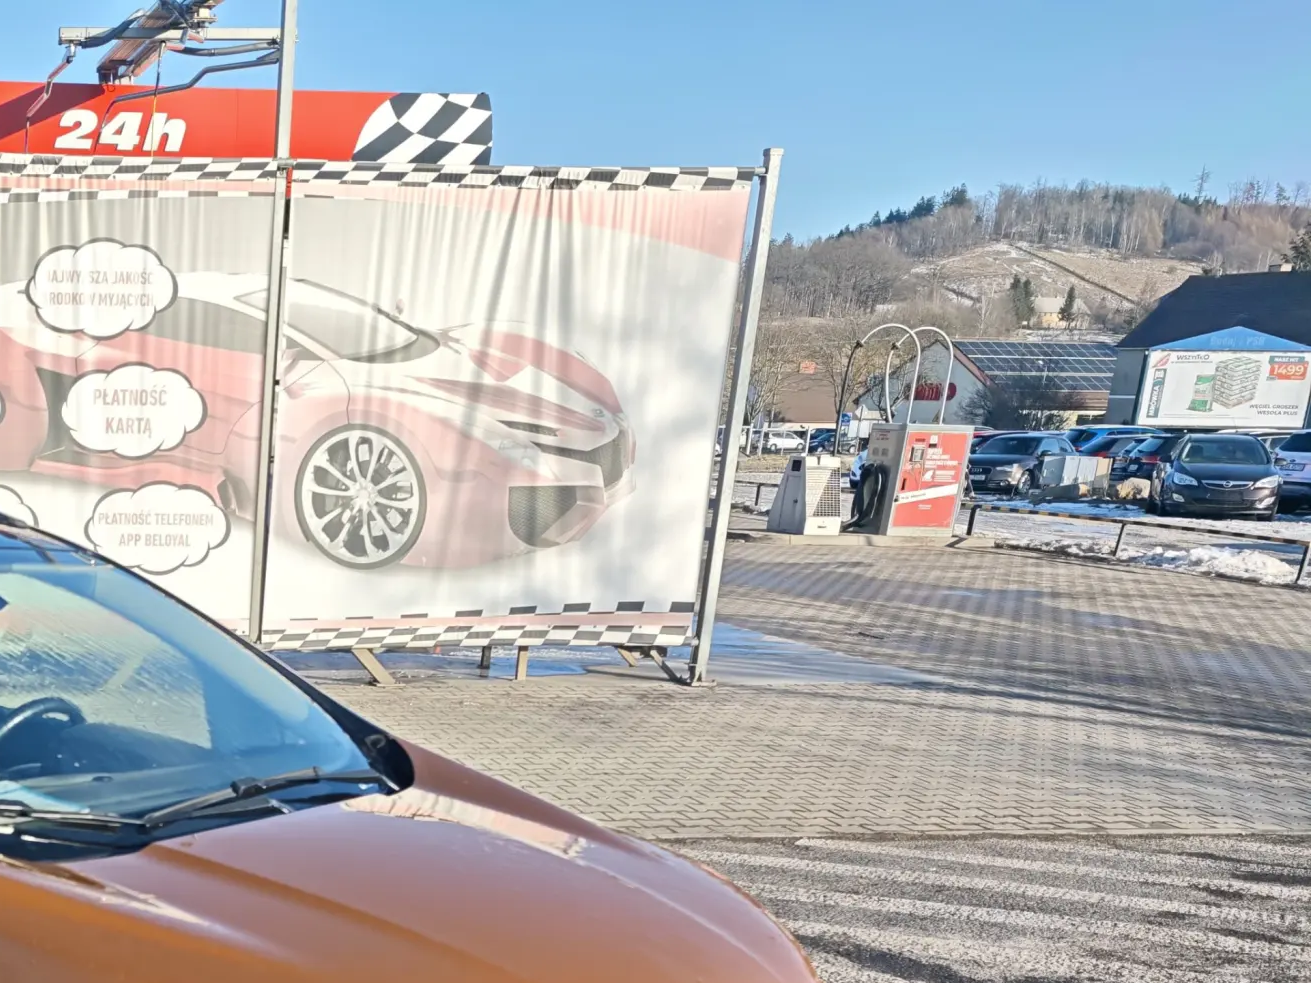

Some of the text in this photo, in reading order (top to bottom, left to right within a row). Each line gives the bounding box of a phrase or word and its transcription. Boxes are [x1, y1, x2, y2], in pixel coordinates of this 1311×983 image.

[54, 109, 187, 152] 24h
[47, 269, 109, 285] AJWYSZA
[1273, 364, 1304, 376] 1499
[93, 384, 167, 406] PŁATNOŚĆ
[105, 417, 152, 439] KARTĄ
[98, 510, 214, 526] PŁATNOŚĆ TELEFONEM
[118, 533, 191, 547] APP BELOYAL
